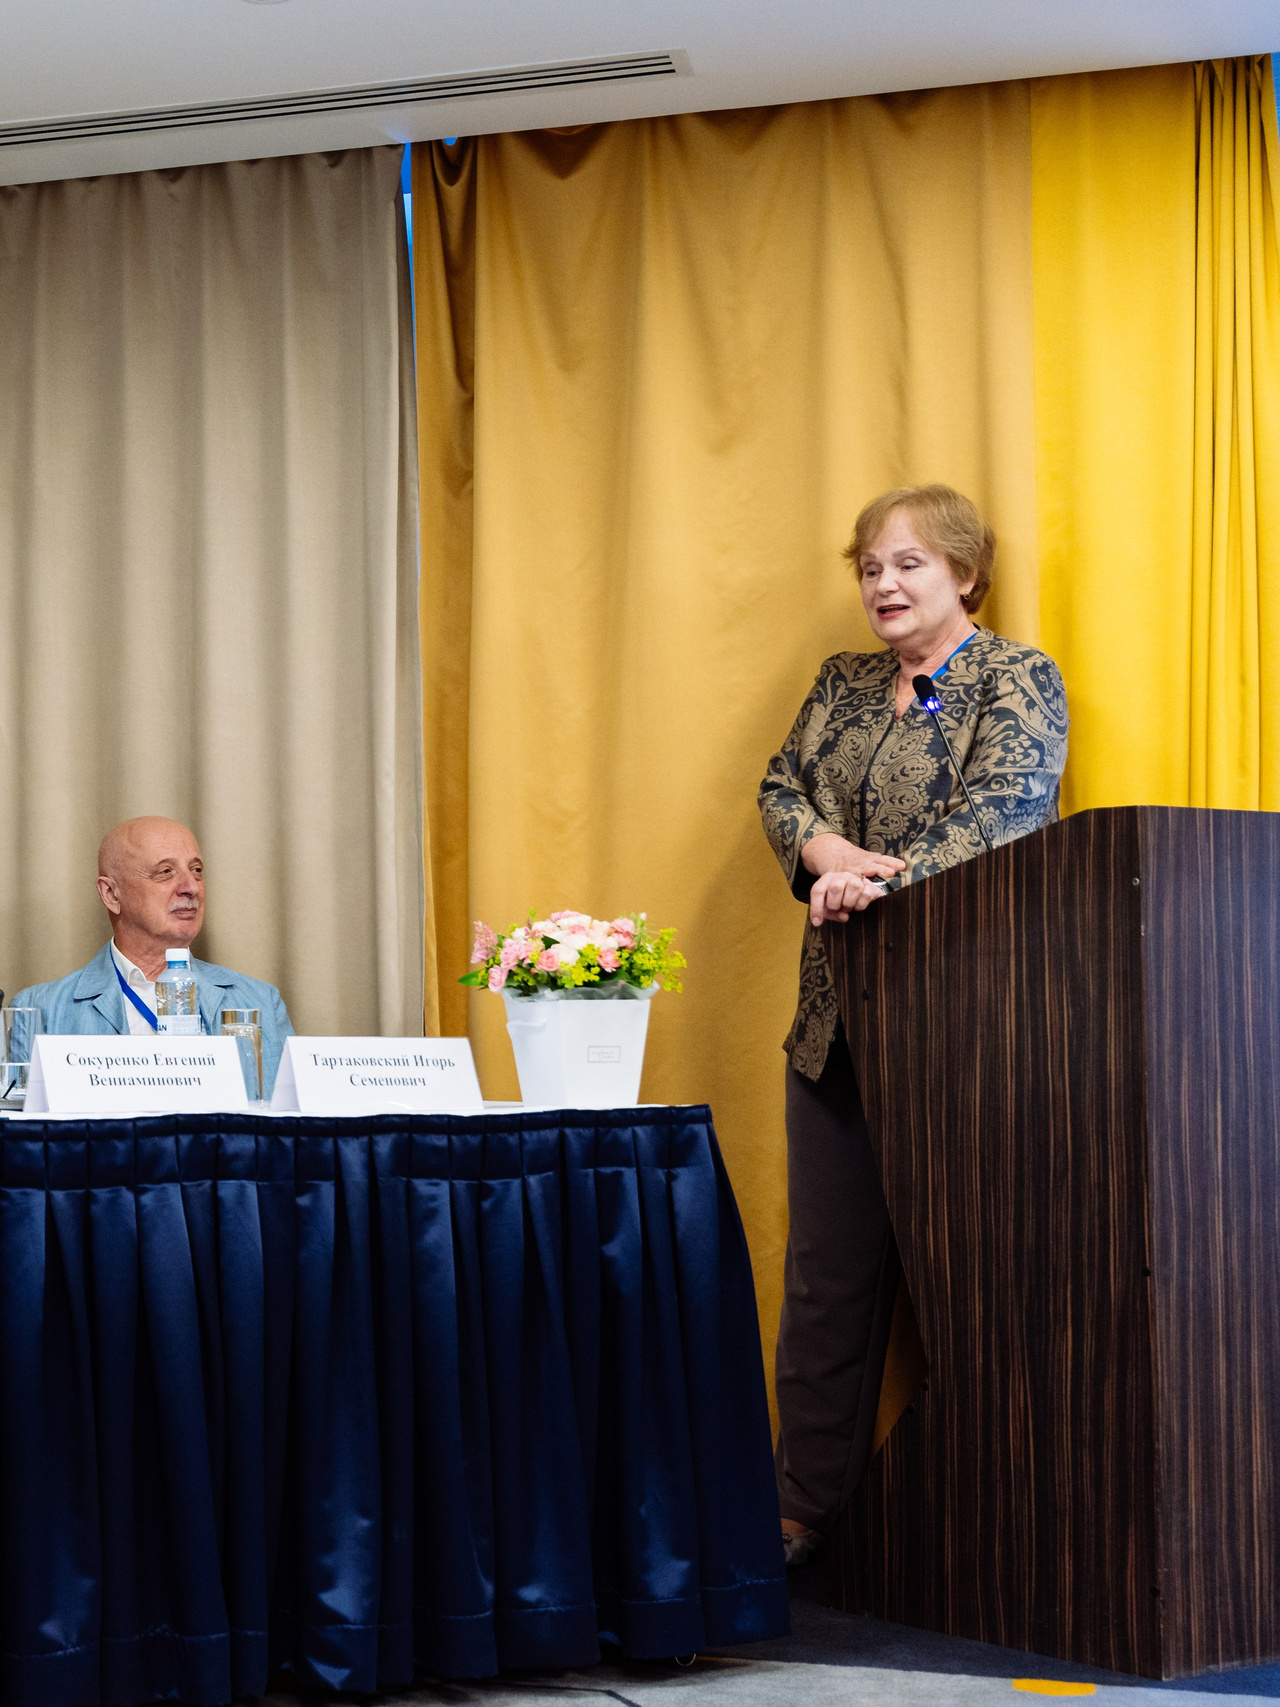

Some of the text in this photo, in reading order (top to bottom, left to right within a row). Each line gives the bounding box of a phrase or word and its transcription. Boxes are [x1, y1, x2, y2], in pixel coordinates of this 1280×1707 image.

[65, 1052, 216, 1070] Сокуренко Евгений
[309, 1053, 456, 1070] Тартаковский Игорь
[88, 1073, 202, 1087] Вениаминович
[349, 1073, 427, 1088] Семенович
